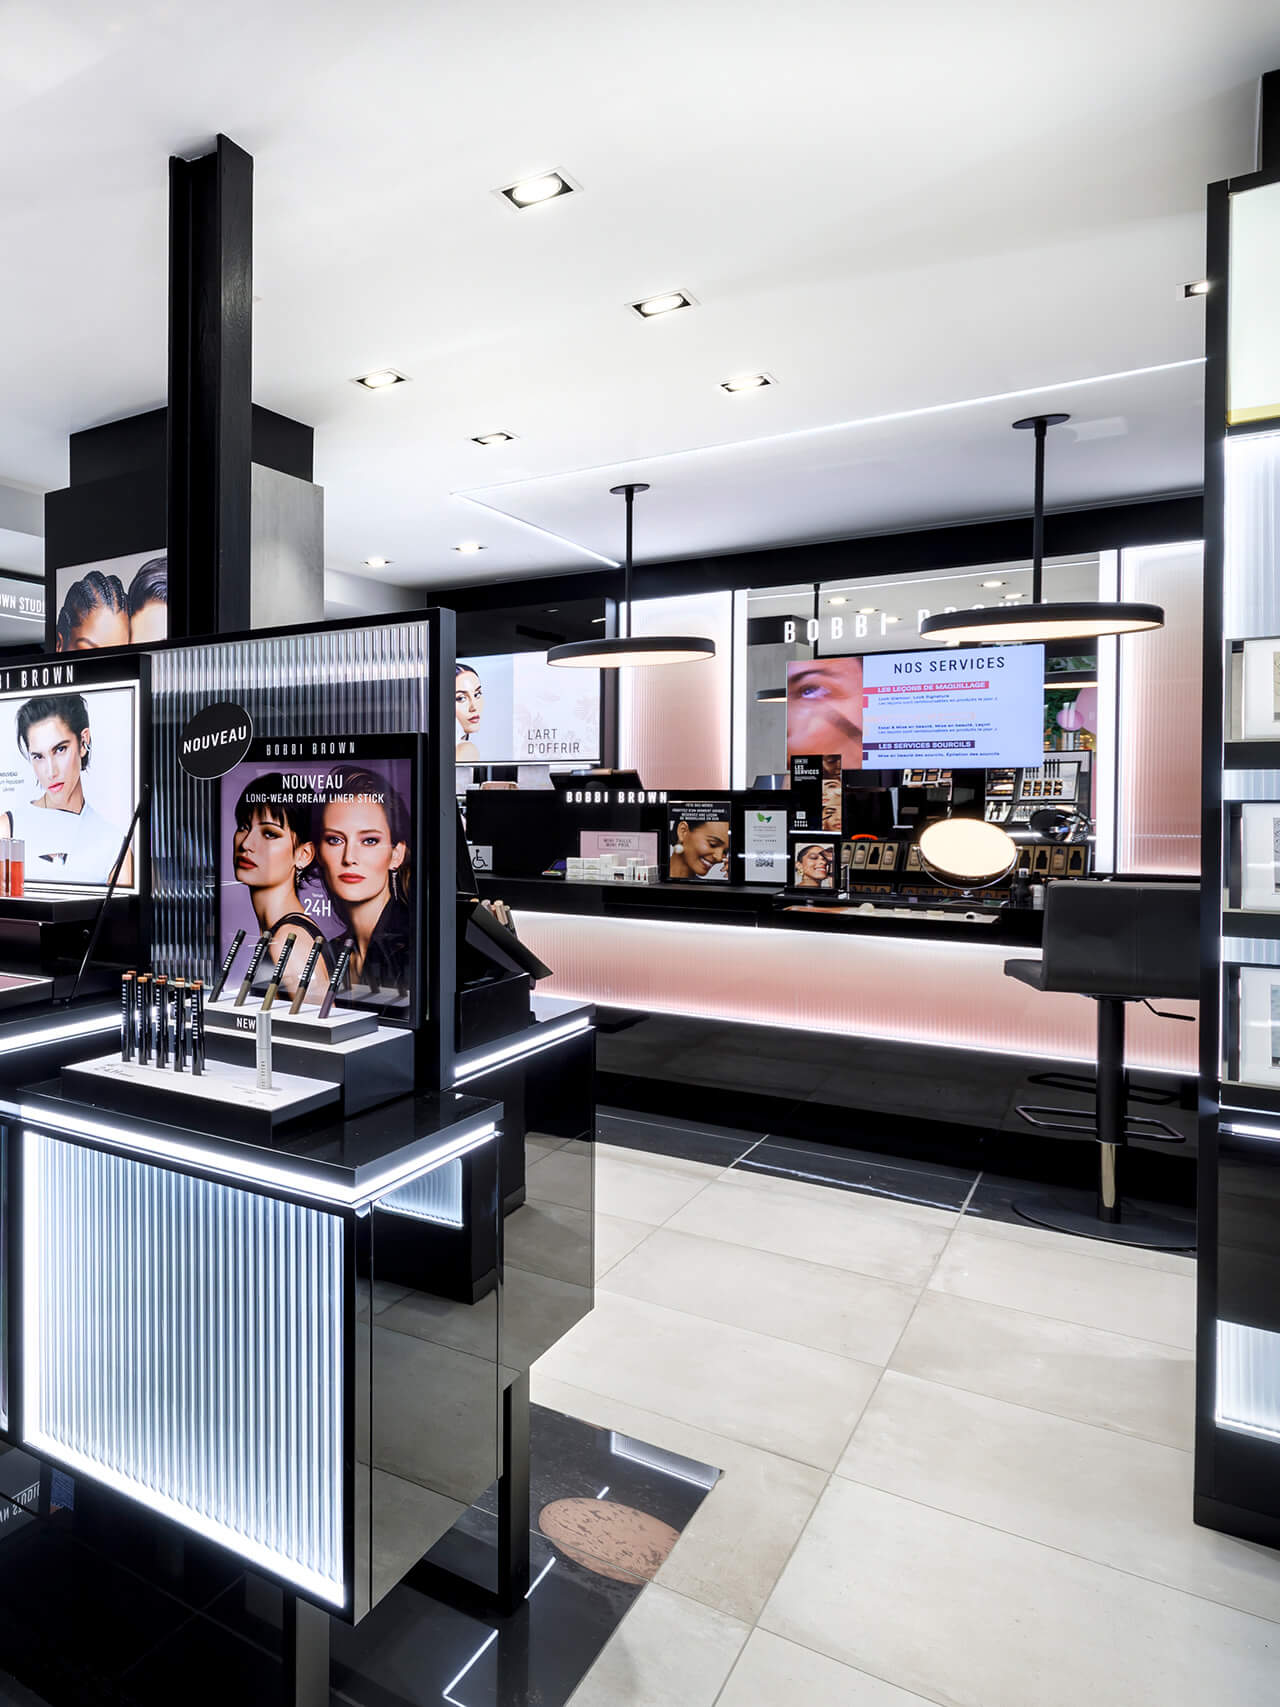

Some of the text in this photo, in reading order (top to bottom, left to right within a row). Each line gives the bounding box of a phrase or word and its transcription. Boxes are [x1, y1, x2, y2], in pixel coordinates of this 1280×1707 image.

[784, 613, 887, 643] BOBBI
[894, 656, 1006, 675] NOS SERVICES
[21, 664, 75, 689] BROWN
[183, 725, 248, 755] NOUVEAU
[527, 728, 558, 741] L'ART
[266, 742, 356, 756] BOBBI BROWN
[527, 742, 580, 755] D'OFFRIR
[932, 741, 971, 749] SOURCILS
[282, 774, 344, 790] NOUVEAU
[245, 793, 385, 804] LONG-WEAR CREAM LINER STICK
[566, 791, 668, 804] BOBBI BROWN
[304, 898, 331, 917] 24H
[236, 1017, 257, 1030] NEW
